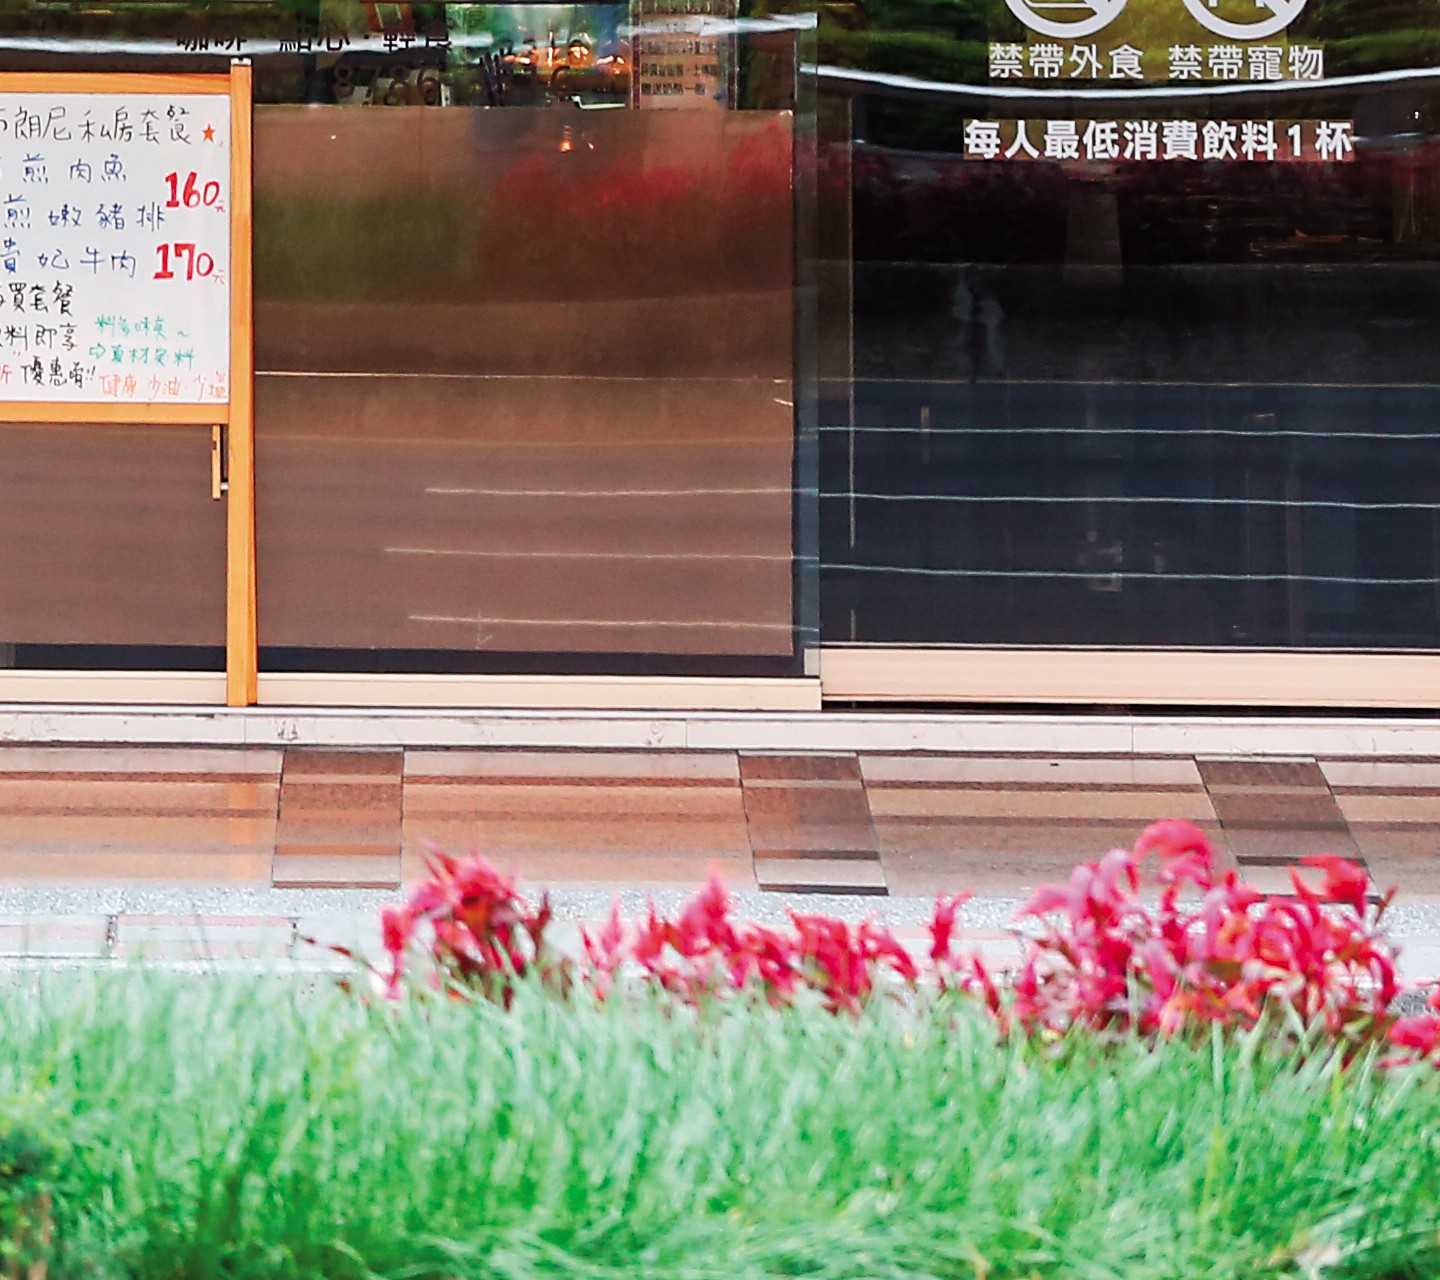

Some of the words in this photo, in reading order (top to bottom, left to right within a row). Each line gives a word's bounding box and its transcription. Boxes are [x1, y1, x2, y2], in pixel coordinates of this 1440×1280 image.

[989, 42, 1144, 80] 禁帶外食
[1168, 42, 1325, 81] 禁帶寵物
[964, 120, 1354, 161] 每人最低消費飲料1杯
[0, 237, 137, 278] 貴妃牛肉
